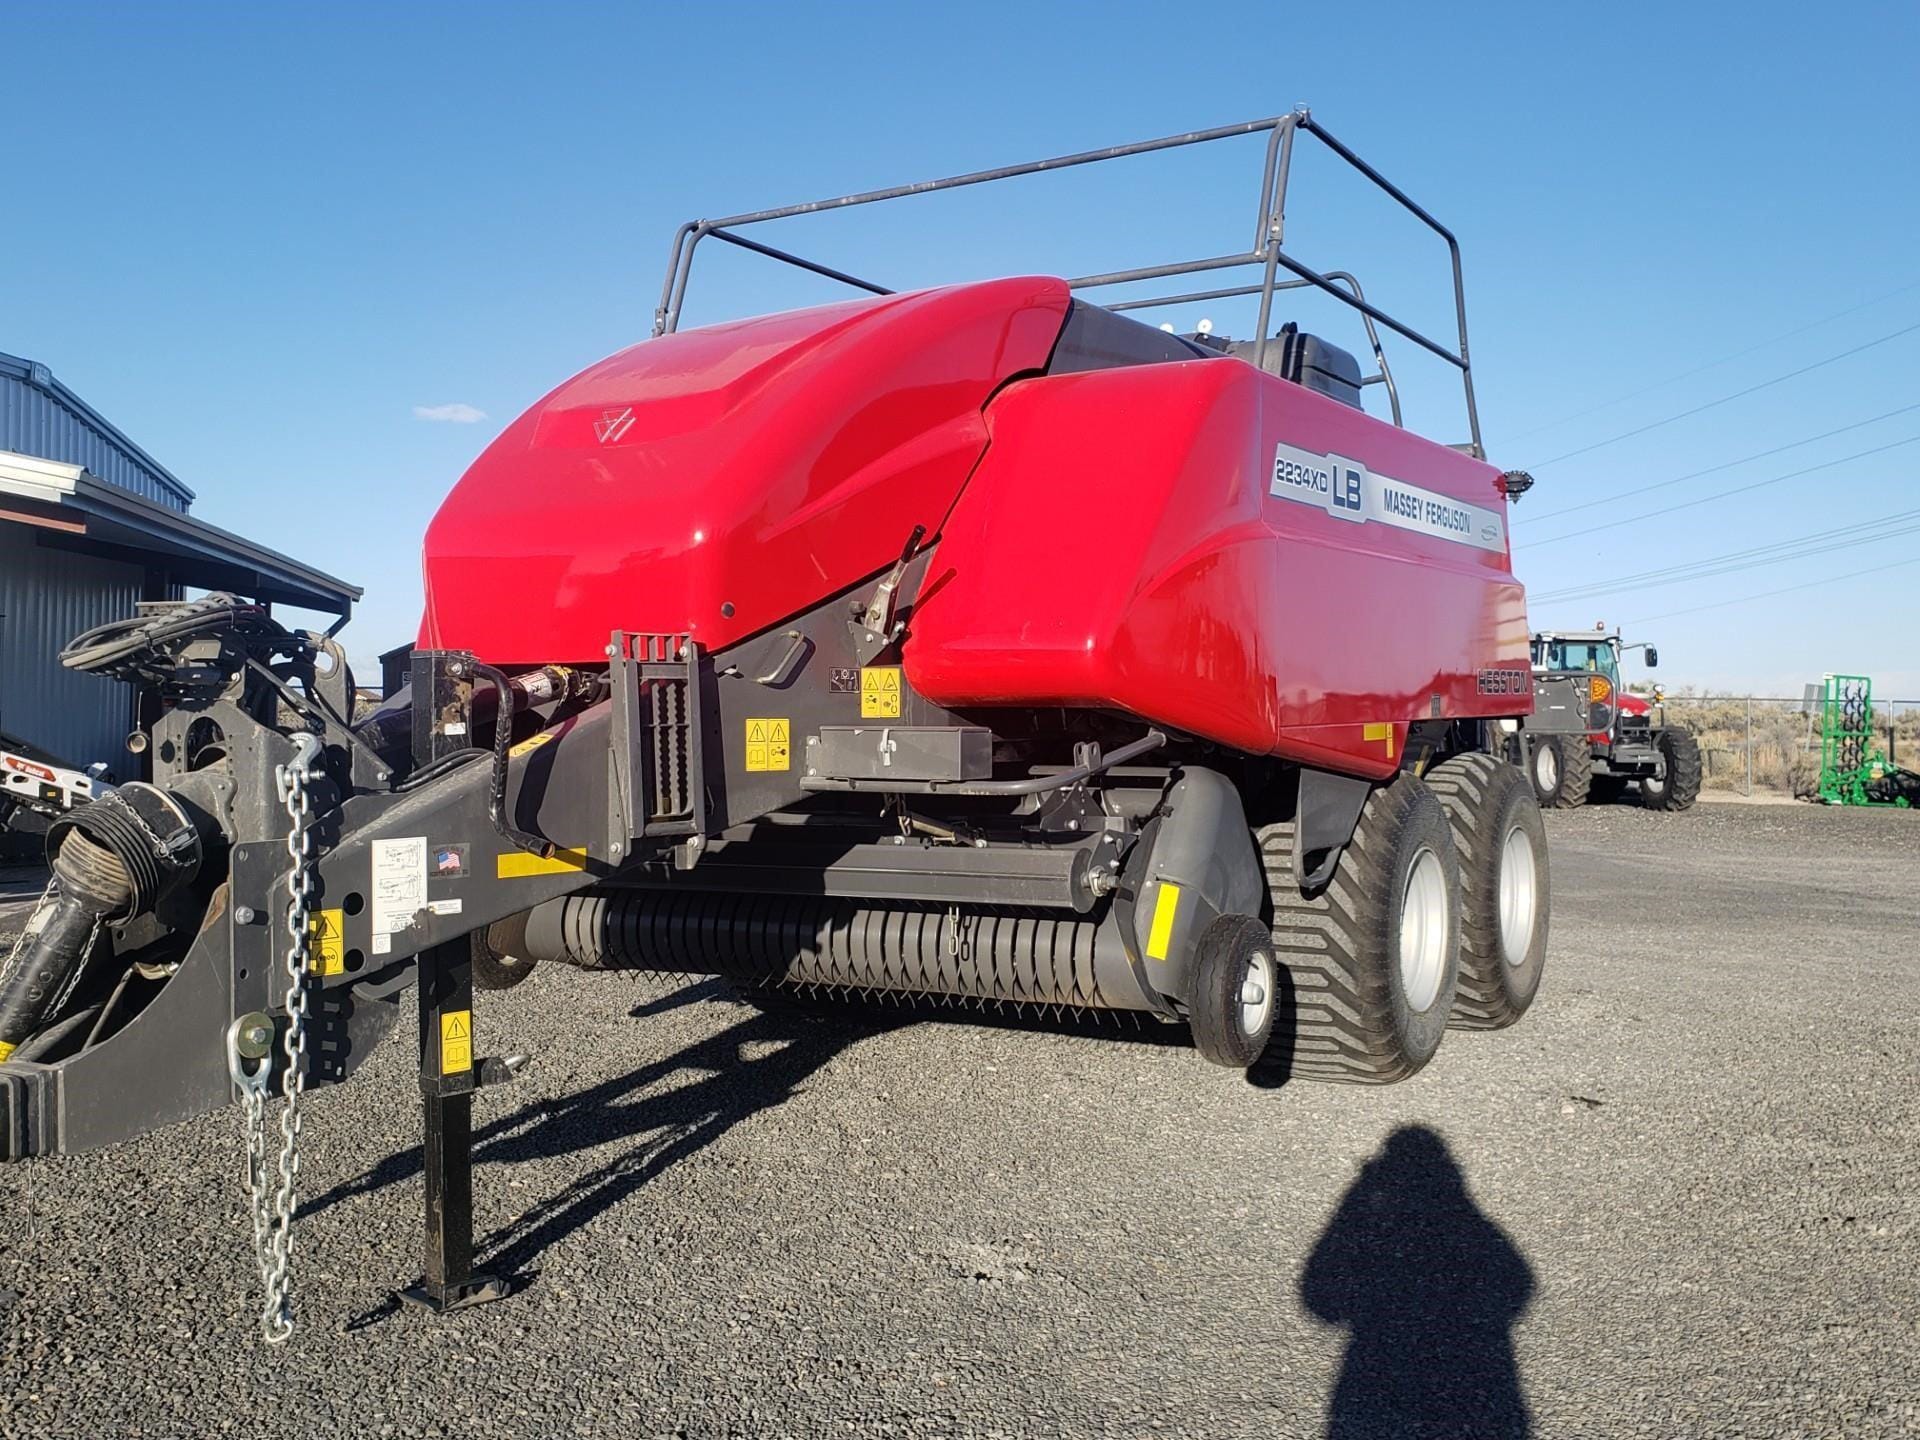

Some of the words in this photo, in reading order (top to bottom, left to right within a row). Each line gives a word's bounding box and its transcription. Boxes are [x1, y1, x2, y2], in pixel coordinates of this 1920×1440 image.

[1276, 459, 1328, 493] 2234XD
[1332, 464, 1361, 511] LB
[1383, 487, 1424, 521] MASSEY
[1425, 501, 1471, 534] FERGUSON
[1477, 669, 1528, 695] HESSTON
